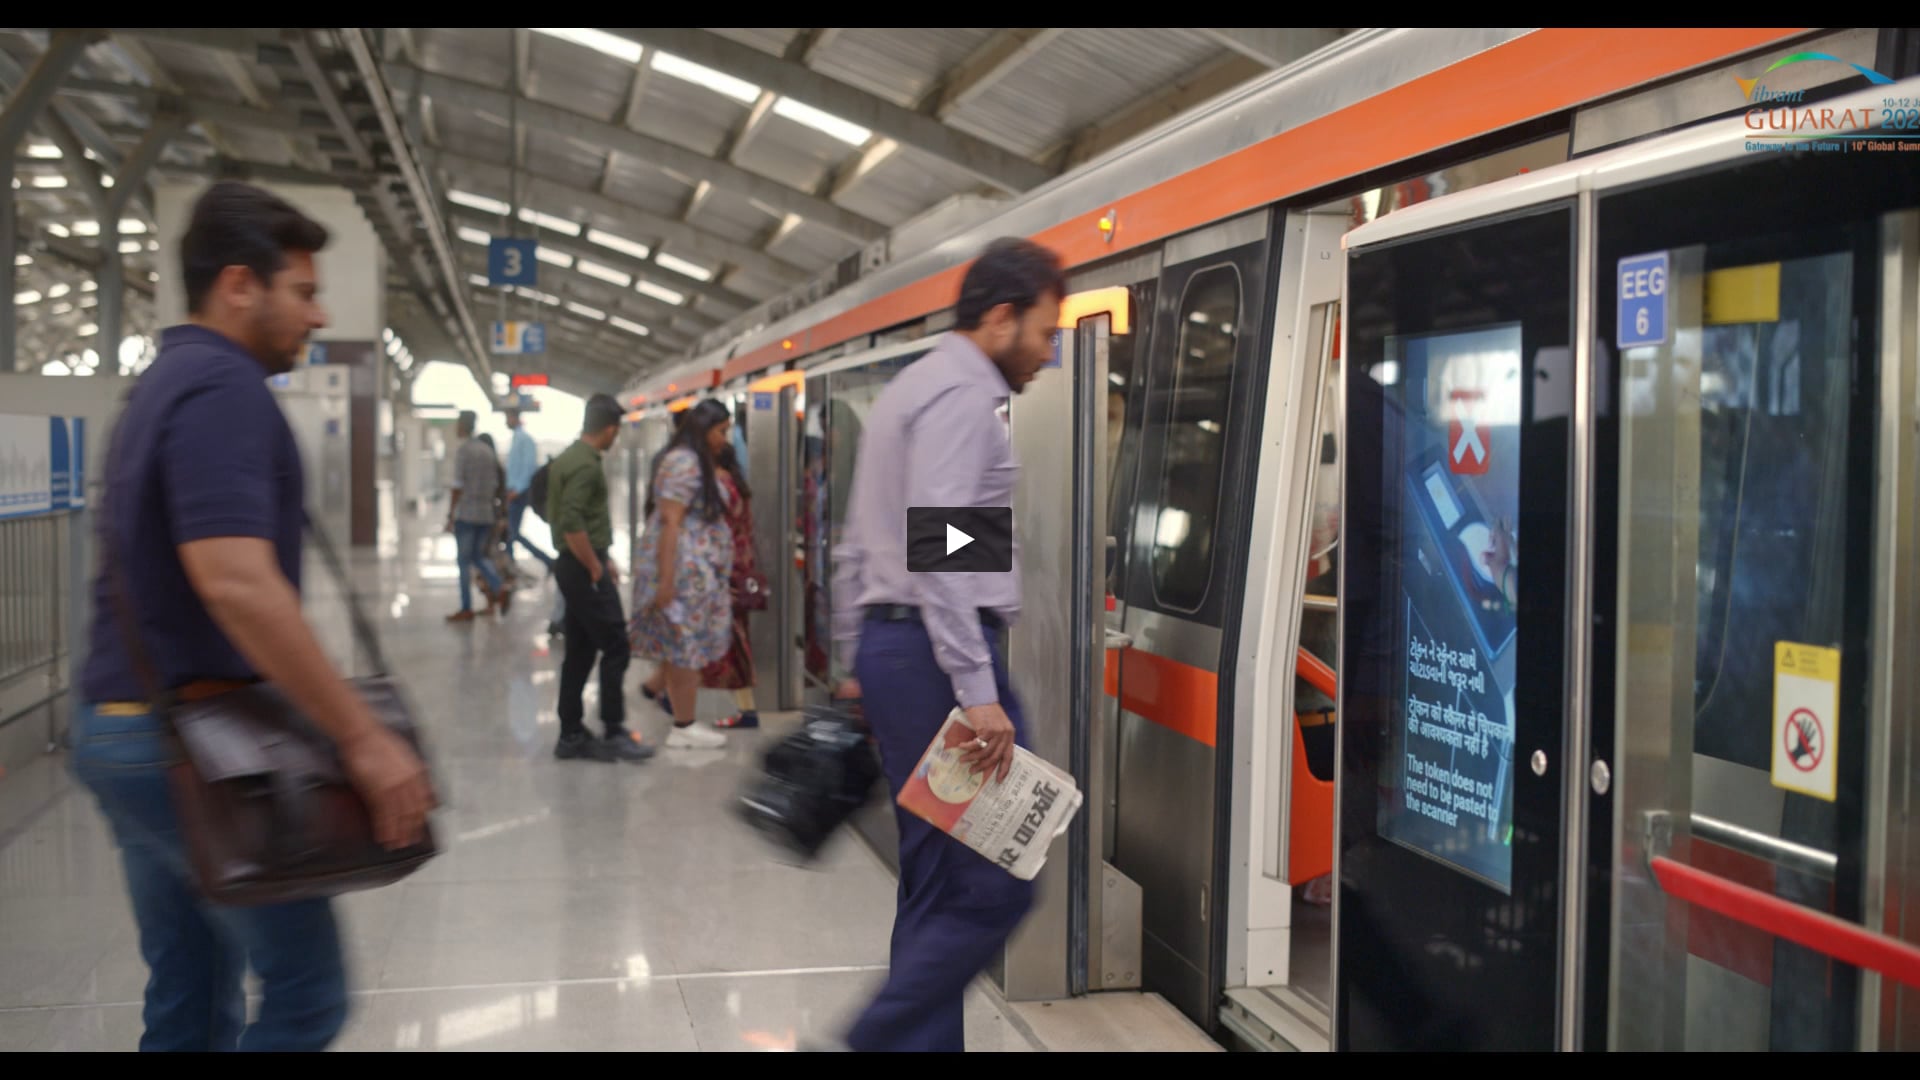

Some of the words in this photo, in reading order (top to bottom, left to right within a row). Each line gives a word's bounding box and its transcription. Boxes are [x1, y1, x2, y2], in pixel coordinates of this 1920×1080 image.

[503, 247, 522, 277] 3
[1622, 267, 1665, 299] EEG
[1635, 307, 1650, 336] 6
[1468, 671, 1485, 694] નથી
[1408, 694, 1430, 718] टोकन
[1430, 700, 1442, 722] को
[1467, 710, 1476, 732] से
[1408, 713, 1419, 734] की
[1420, 721, 1463, 749] आवश्यकता
[1481, 734, 1489, 759] है
[1407, 753, 1423, 774] The
[1424, 761, 1450, 784] token
[1451, 769, 1475, 793] does
[1476, 781, 1493, 800] not
[1013, 780, 1060, 847] ગુજરાત
[1406, 776, 1428, 796] need
[1429, 782, 1439, 800] to
[1440, 784, 1452, 805] be
[1453, 793, 1487, 819] pasted
[1488, 803, 1499, 823] to
[1406, 792, 1420, 813] the
[1421, 801, 1458, 828] scanner
